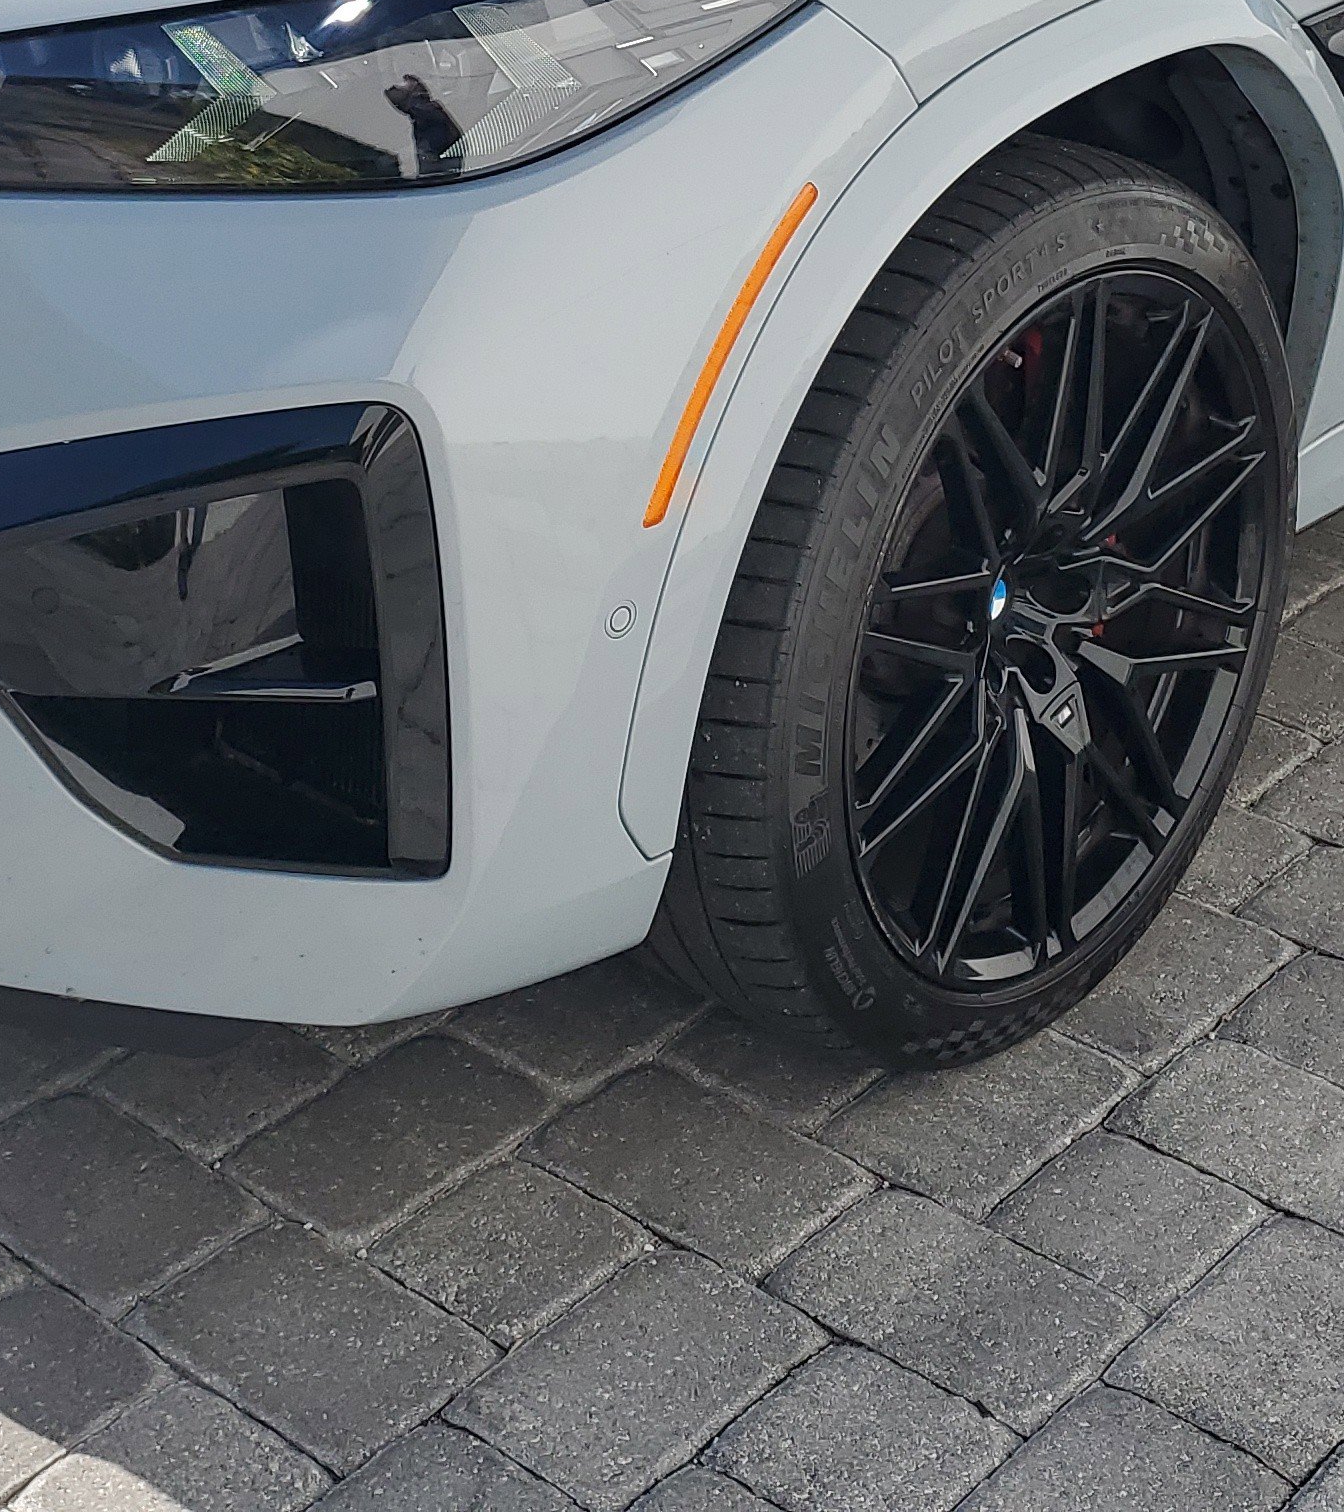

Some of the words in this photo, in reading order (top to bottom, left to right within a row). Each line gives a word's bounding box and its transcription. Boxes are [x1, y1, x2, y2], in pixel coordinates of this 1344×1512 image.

[910, 320, 968, 410] PILOT
[971, 248, 1038, 324] SPORT
[794, 423, 901, 777] MICHELIN
